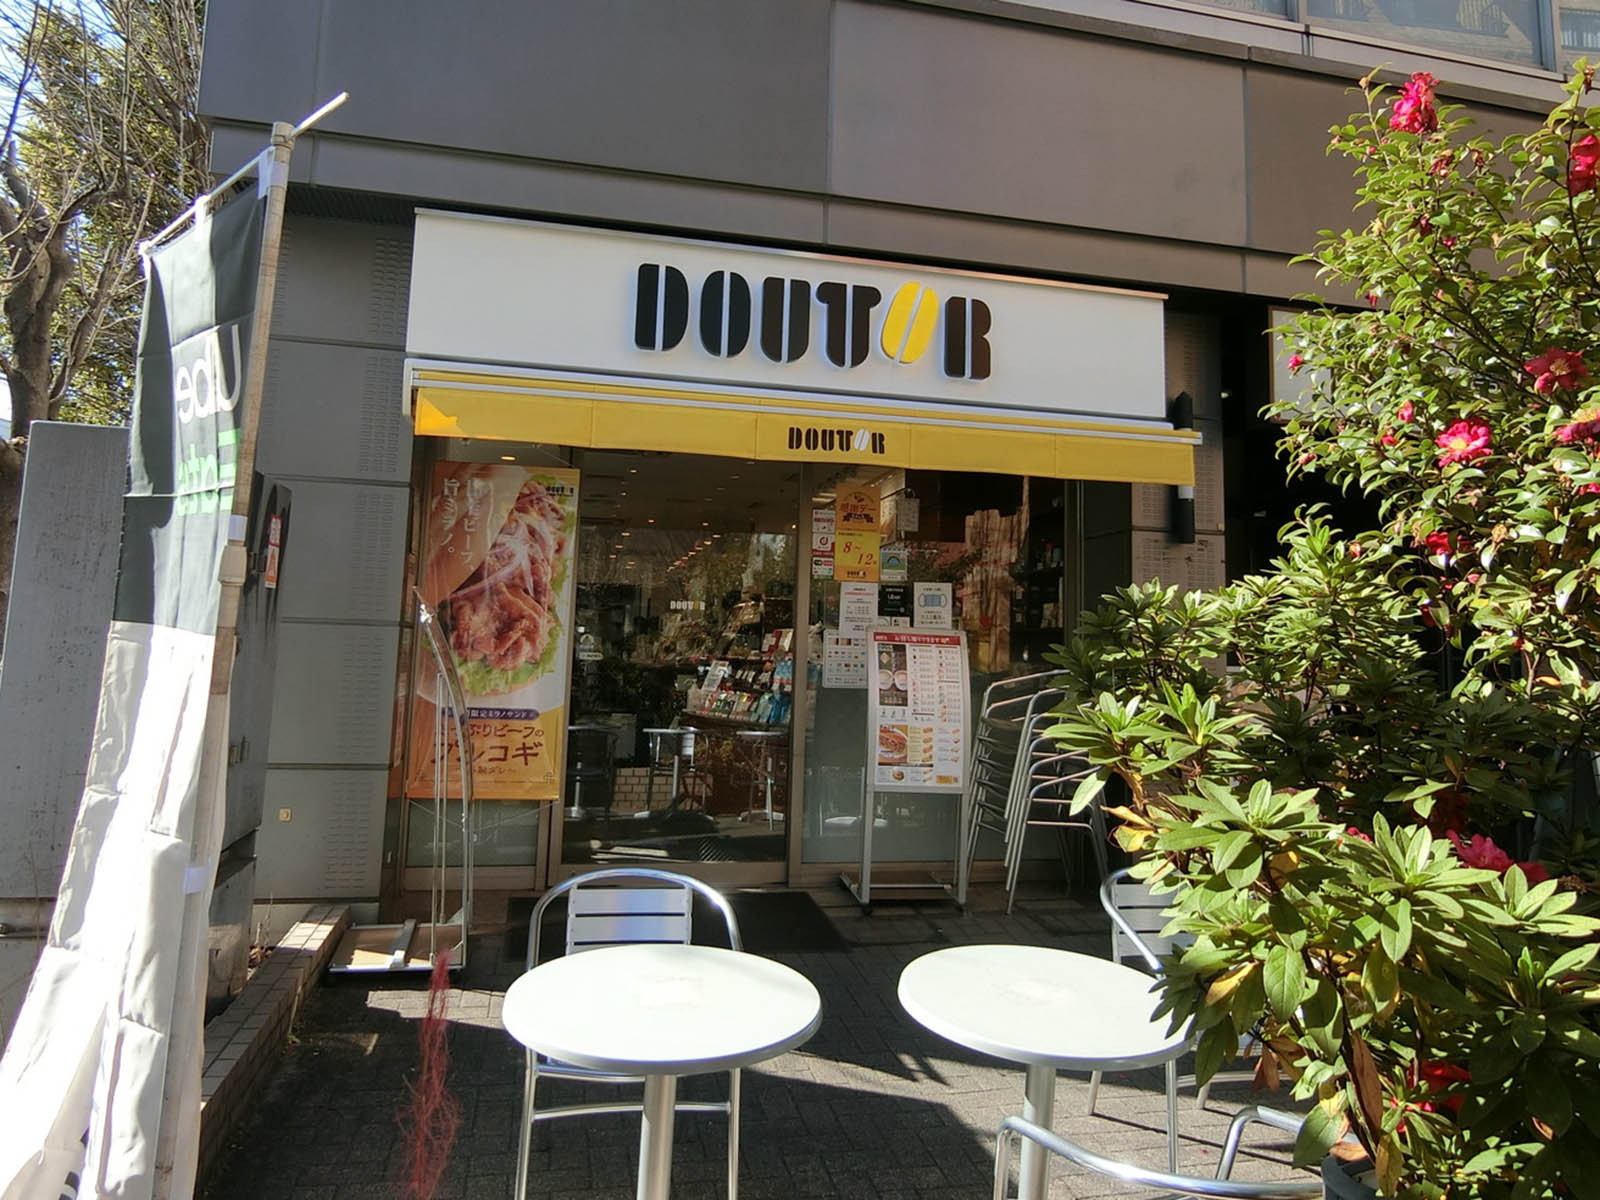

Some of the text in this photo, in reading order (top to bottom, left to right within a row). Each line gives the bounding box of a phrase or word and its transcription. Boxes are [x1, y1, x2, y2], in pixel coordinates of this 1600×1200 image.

[634, 263, 993, 380] DOUTOR
[788, 427, 886, 454] DOUTOR
[670, 600, 705, 610] DOUTOR
